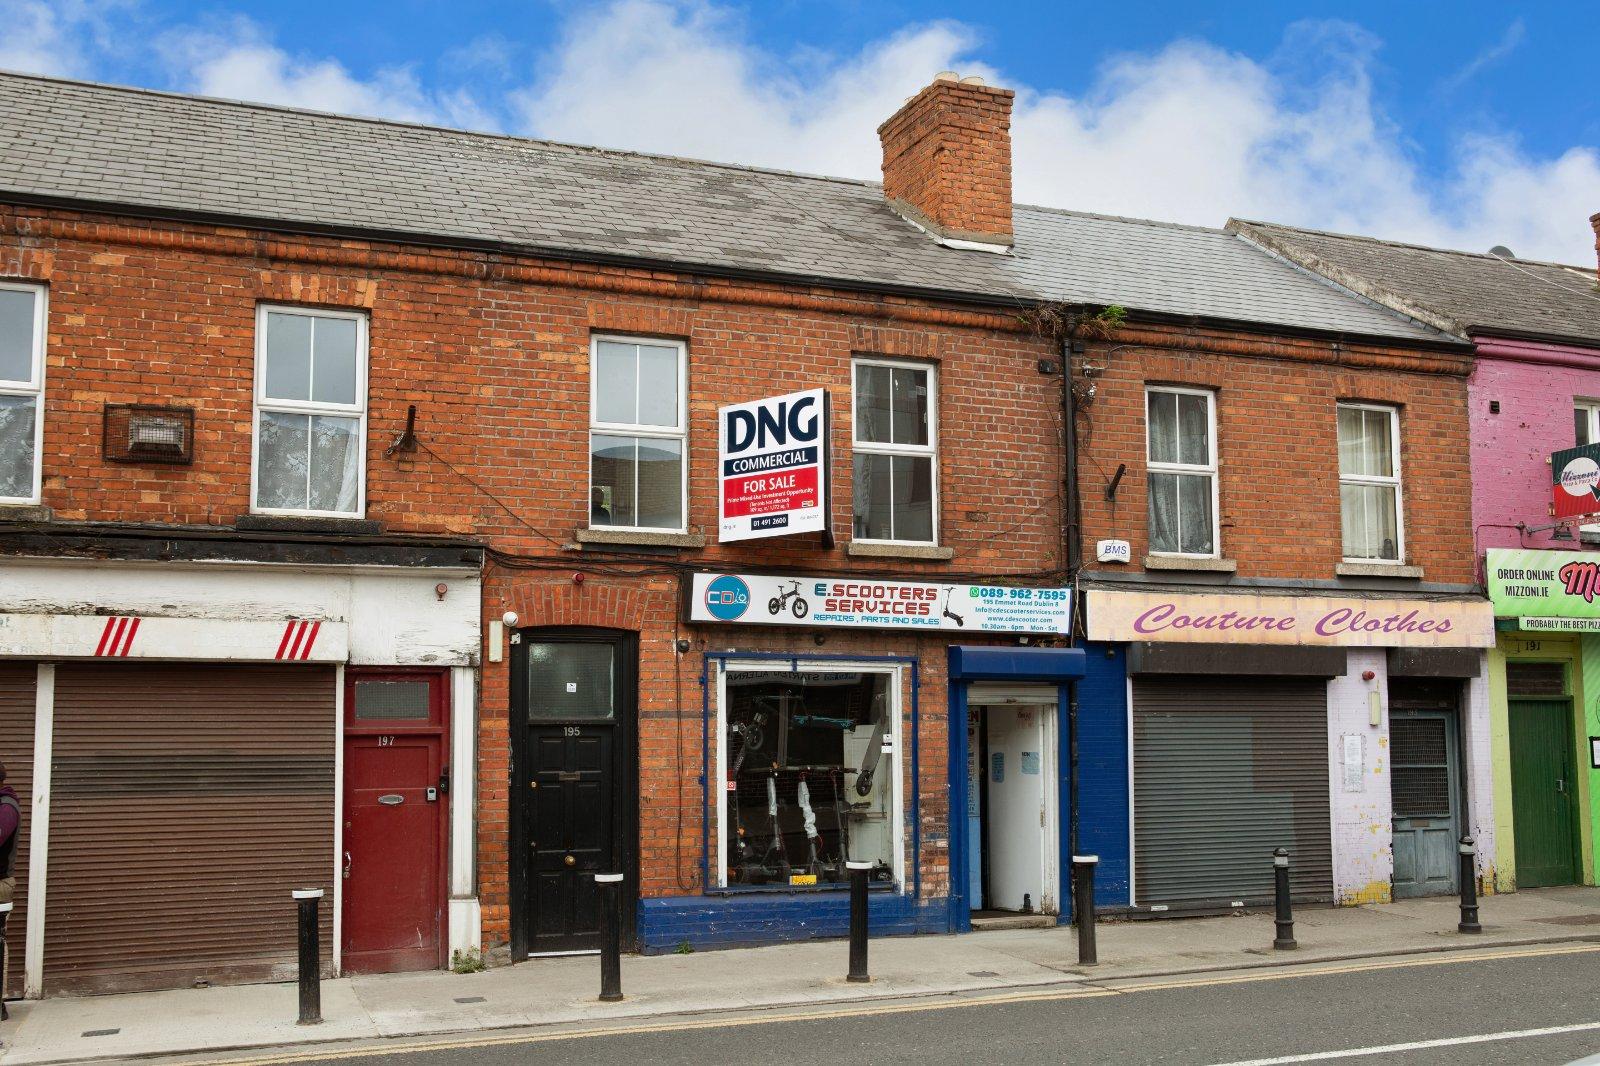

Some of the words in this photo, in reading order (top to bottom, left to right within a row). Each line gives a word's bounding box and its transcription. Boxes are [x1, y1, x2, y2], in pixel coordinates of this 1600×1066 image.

[727, 397, 818, 454] DNG
[733, 451, 809, 473] COMMERCIAL
[744, 480, 766, 494] FOR
[770, 475, 796, 491] SALE
[762, 492, 785, 500] Investment
[787, 488, 814, 497] Opportunity
[773, 517, 786, 525] 2600
[1105, 545, 1127, 554] BMS
[1498, 569, 1524, 580] ORDER
[1527, 570, 1555, 581] ONLINE
[814, 583, 938, 601] E.SCOOTERS
[1506, 586, 1549, 597] MIZZONI.IE
[825, 599, 930, 615] SERVICES
[861, 616, 890, 624] PARTS
[1133, 604, 1296, 634] Couture
[1314, 607, 1454, 637] Clothes
[1527, 620, 1558, 629] PROBABLY
[1573, 621, 1587, 629] BEST
[1526, 641, 1540, 651] 191
[564, 727, 580, 736] 195
[378, 736, 395, 746] 197
